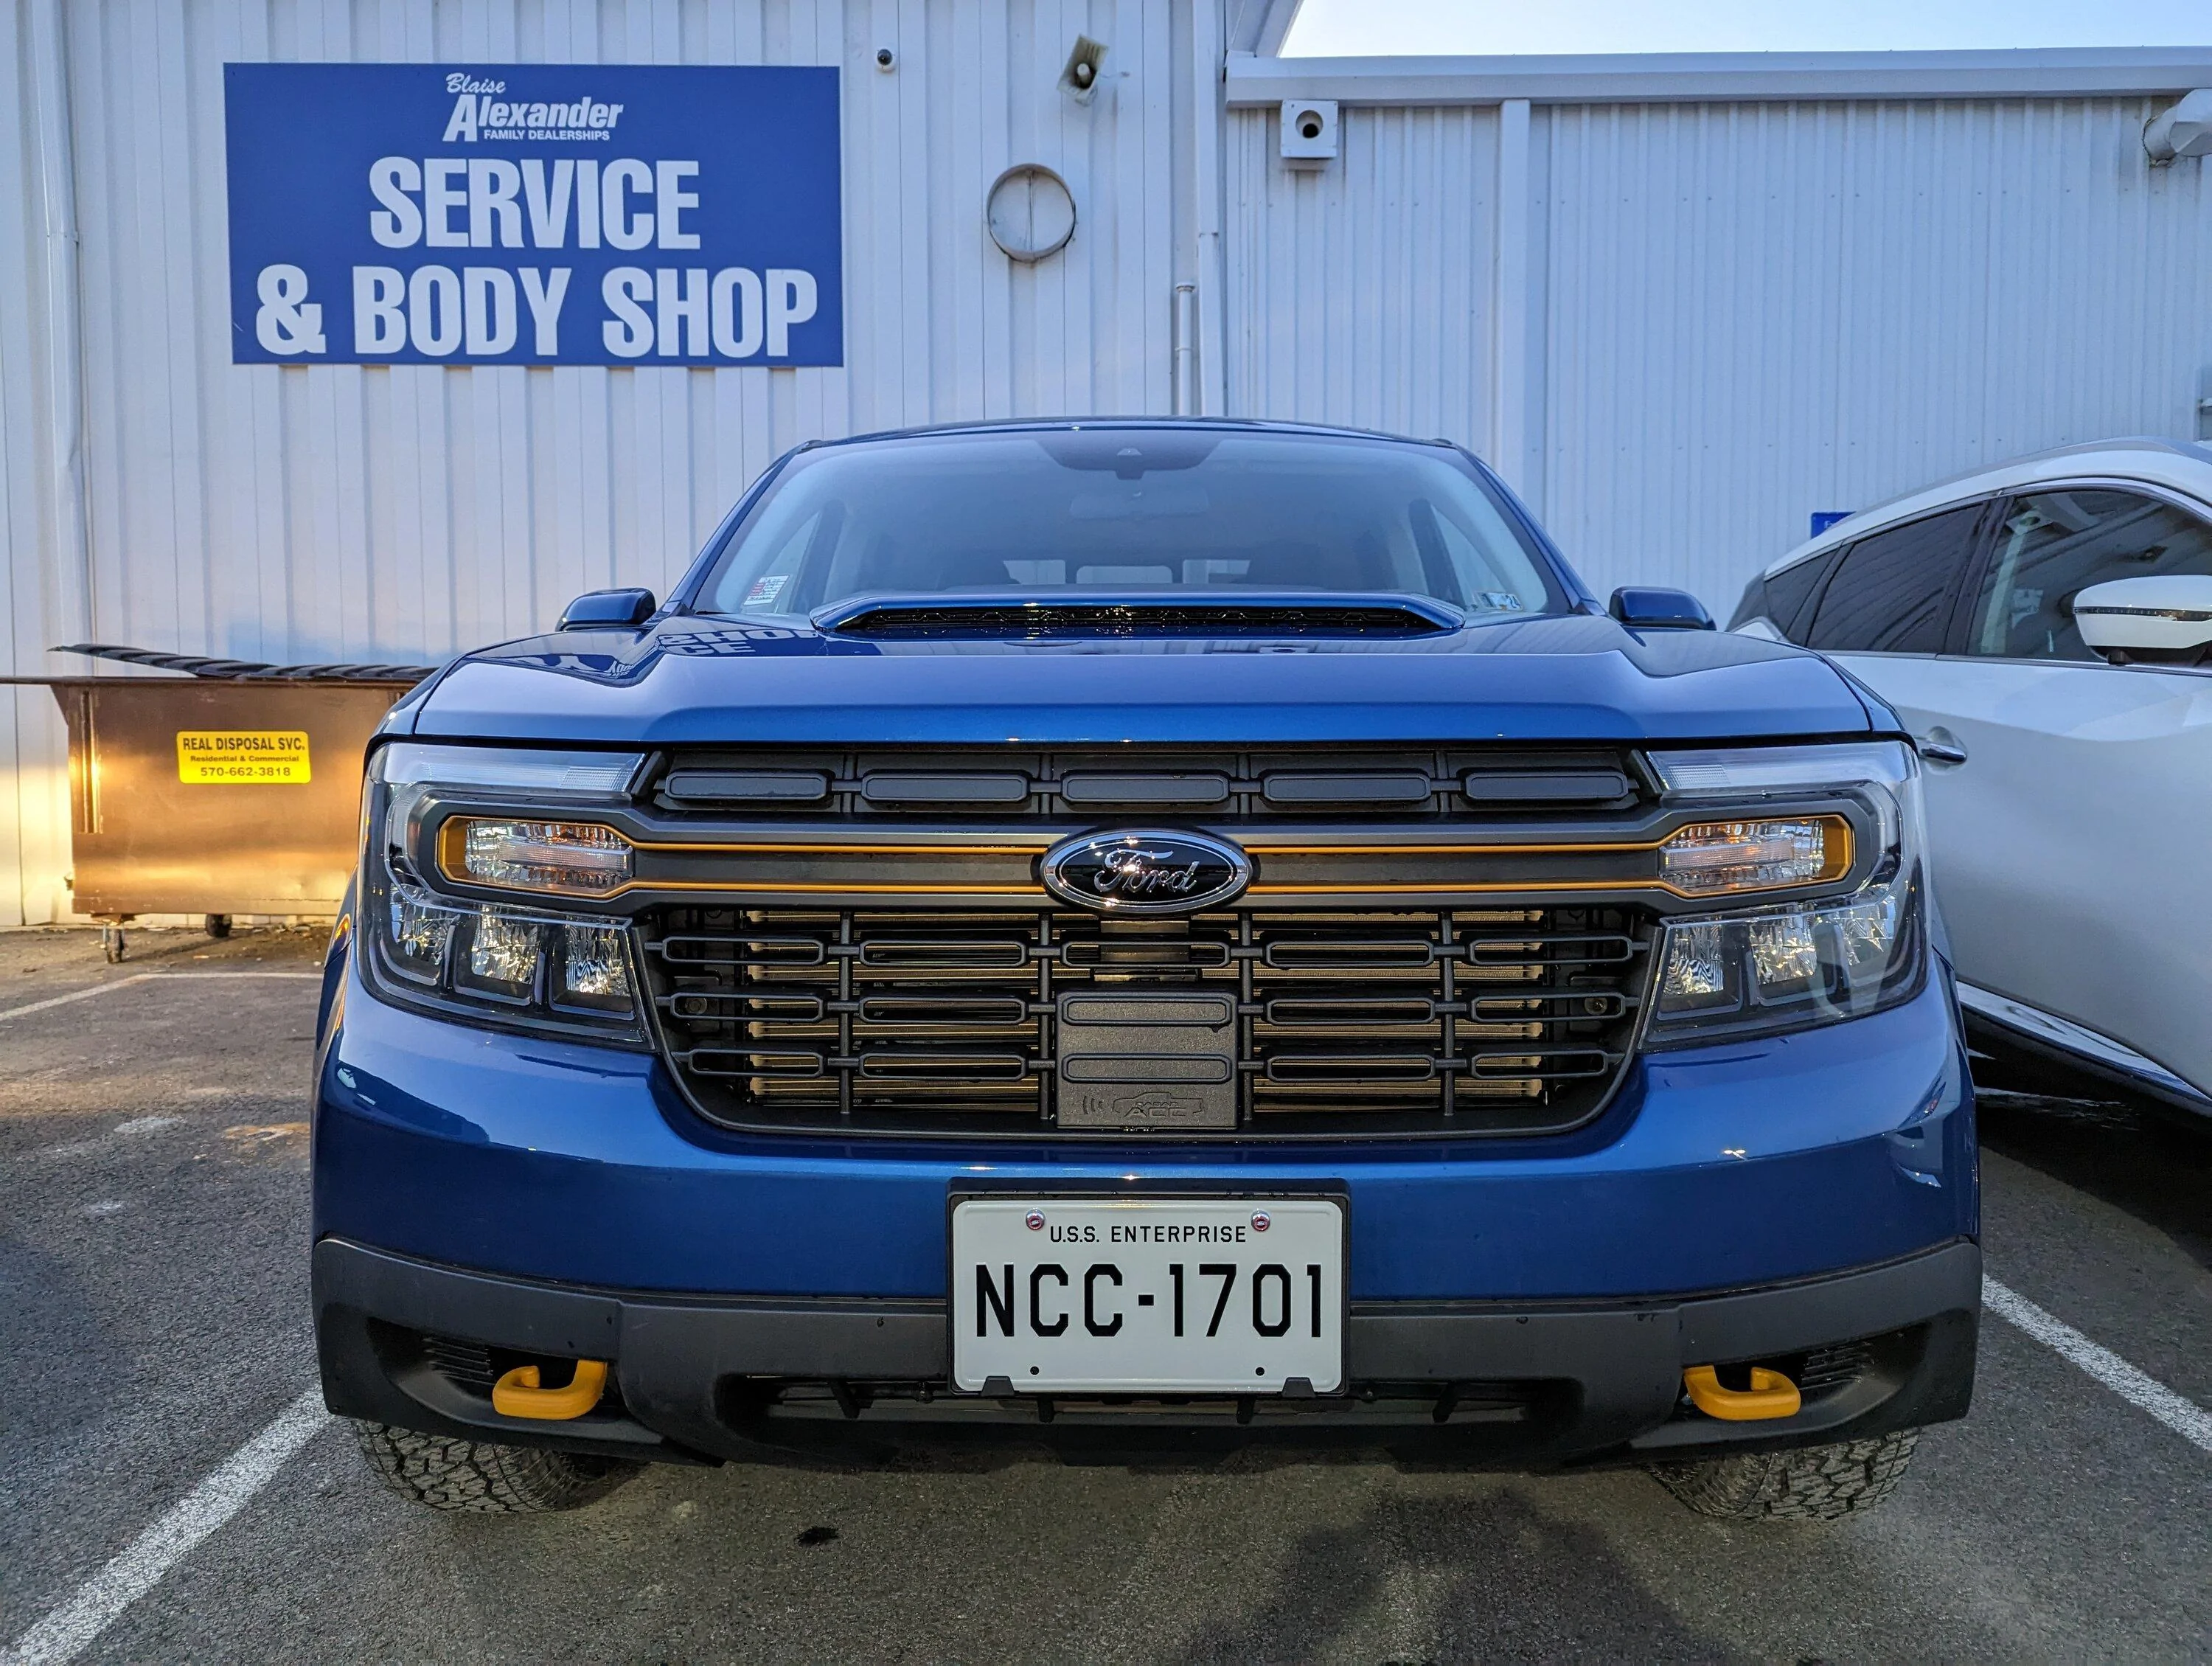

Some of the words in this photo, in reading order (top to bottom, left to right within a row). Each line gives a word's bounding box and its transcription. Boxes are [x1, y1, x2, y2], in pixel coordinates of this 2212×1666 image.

[445, 72, 507, 94] Blaise
[442, 94, 625, 142] Alexander
[484, 129, 526, 140] FAMILY
[528, 130, 611, 141] DEALERSHIPS
[369, 156, 701, 251] SERVICE
[256, 263, 326, 355] &
[352, 265, 572, 357] BODY
[602, 266, 818, 359] SHOP
[183, 737, 213, 751] REAL
[215, 737, 275, 751] DISPOSAL
[278, 737, 305, 751] SVC.
[190, 754, 237, 763] Residential
[200, 766, 291, 777] 570-662-3818
[1093, 848, 1200, 893] Ford
[1049, 1226, 1100, 1243] U.S.S.
[1110, 1226, 1247, 1243] ENTERPRISE
[975, 1263, 1322, 1338] NCC-1701
